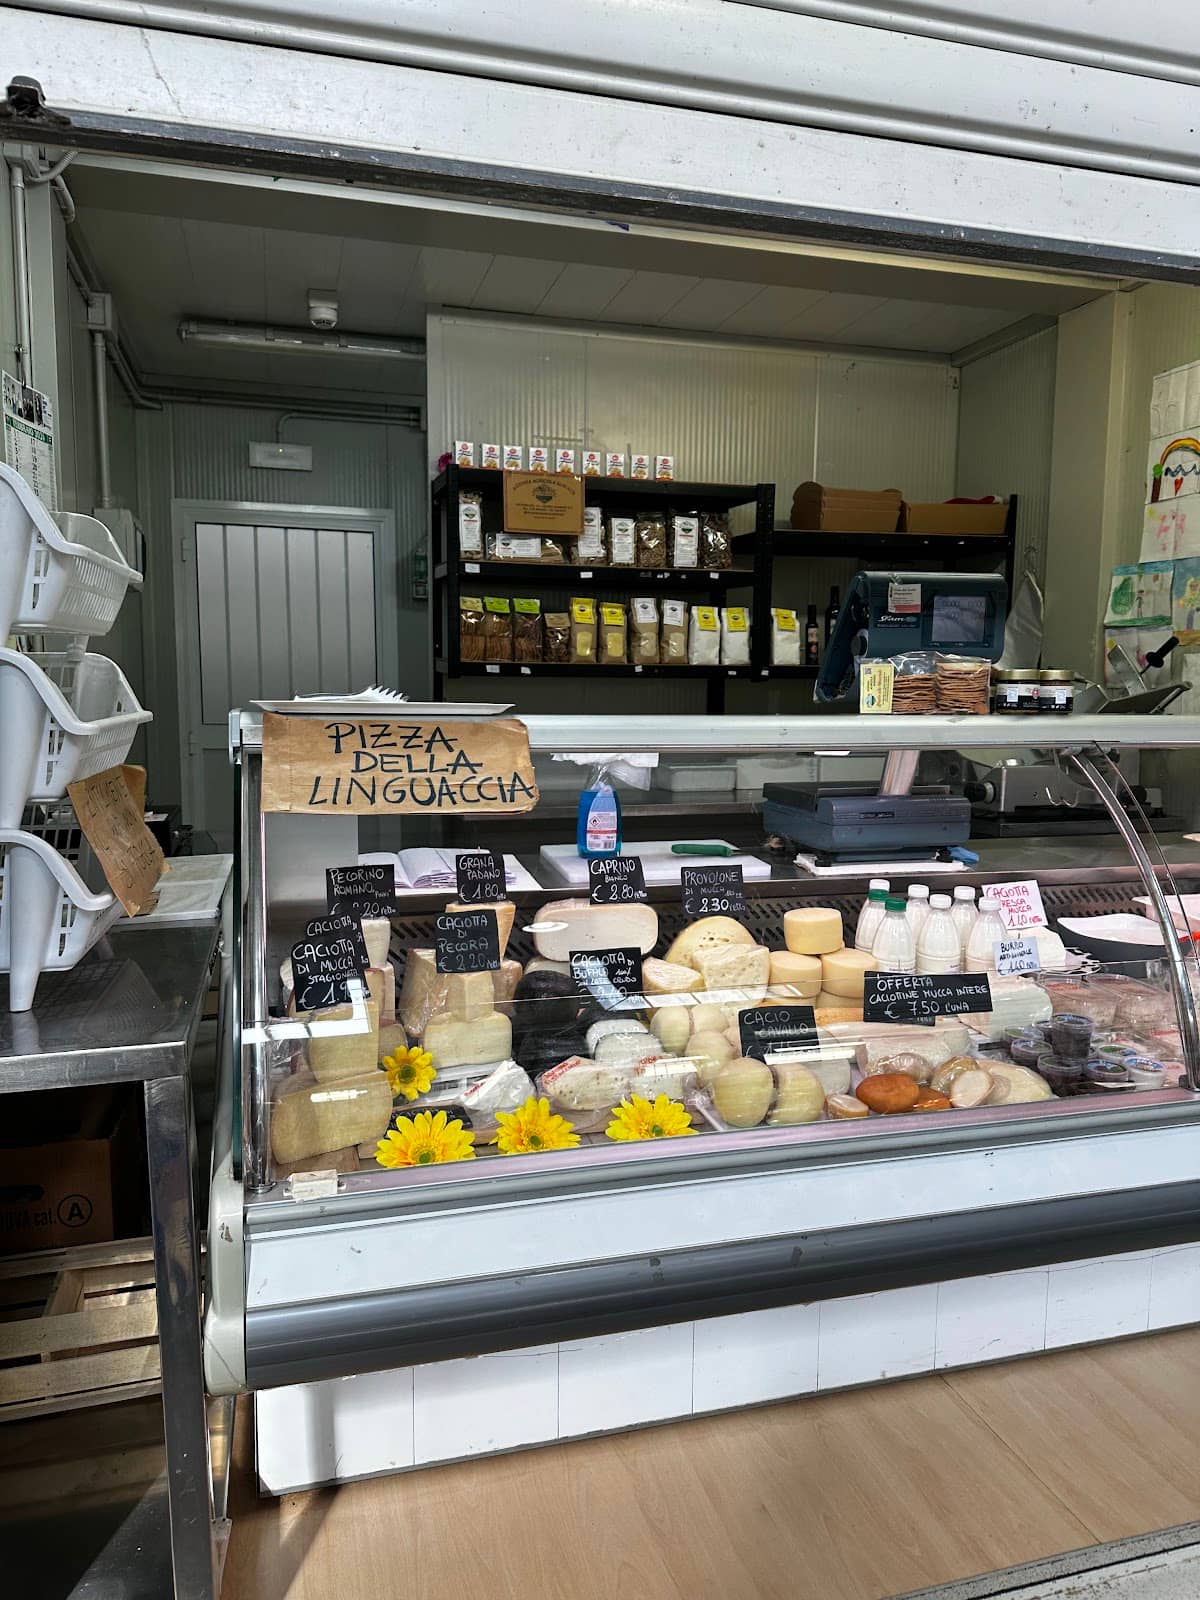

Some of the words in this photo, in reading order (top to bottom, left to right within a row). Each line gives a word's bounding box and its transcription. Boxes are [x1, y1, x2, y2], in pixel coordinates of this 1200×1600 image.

[325, 722, 458, 753] PIZZA
[352, 750, 483, 774] DELLA
[308, 772, 534, 807] LINGUACCIA
[459, 855, 495, 871] GRANA
[591, 859, 635, 875] CAPRINO
[329, 868, 384, 885] PECORINO
[467, 868, 501, 880] PADANO
[684, 870, 739, 886] PROVOLONE
[334, 881, 372, 896] ROMANO
[459, 884, 471, 902] €
[591, 885, 604, 902] €
[609, 884, 634, 900] 2.80
[685, 898, 697, 914] €
[699, 897, 729, 912] 2.30
[1000, 897, 1026, 907] RESCA
[1008, 904, 1033, 915] MUCCA
[306, 915, 353, 937] CACIOTTA
[436, 914, 488, 930] CACIOTTA
[457, 929, 467, 939] DI
[292, 939, 355, 963] CACIOTTA
[437, 937, 489, 953] PECORA
[1001, 942, 1024, 953] BURRO
[296, 963, 310, 975] DI
[320, 956, 354, 973] MUCCA
[438, 956, 453, 972] €
[572, 951, 626, 967] CACIOTTA
[627, 958, 635, 966] DI
[877, 976, 933, 992] OFFERTA
[299, 986, 317, 1010] €
[869, 990, 919, 1005] CACIOTTINE
[923, 987, 953, 999] MUCCA
[956, 984, 988, 996] INTERE
[884, 1001, 900, 1019] €
[907, 1000, 940, 1016] 7.50
[743, 1010, 791, 1027] CACIO
